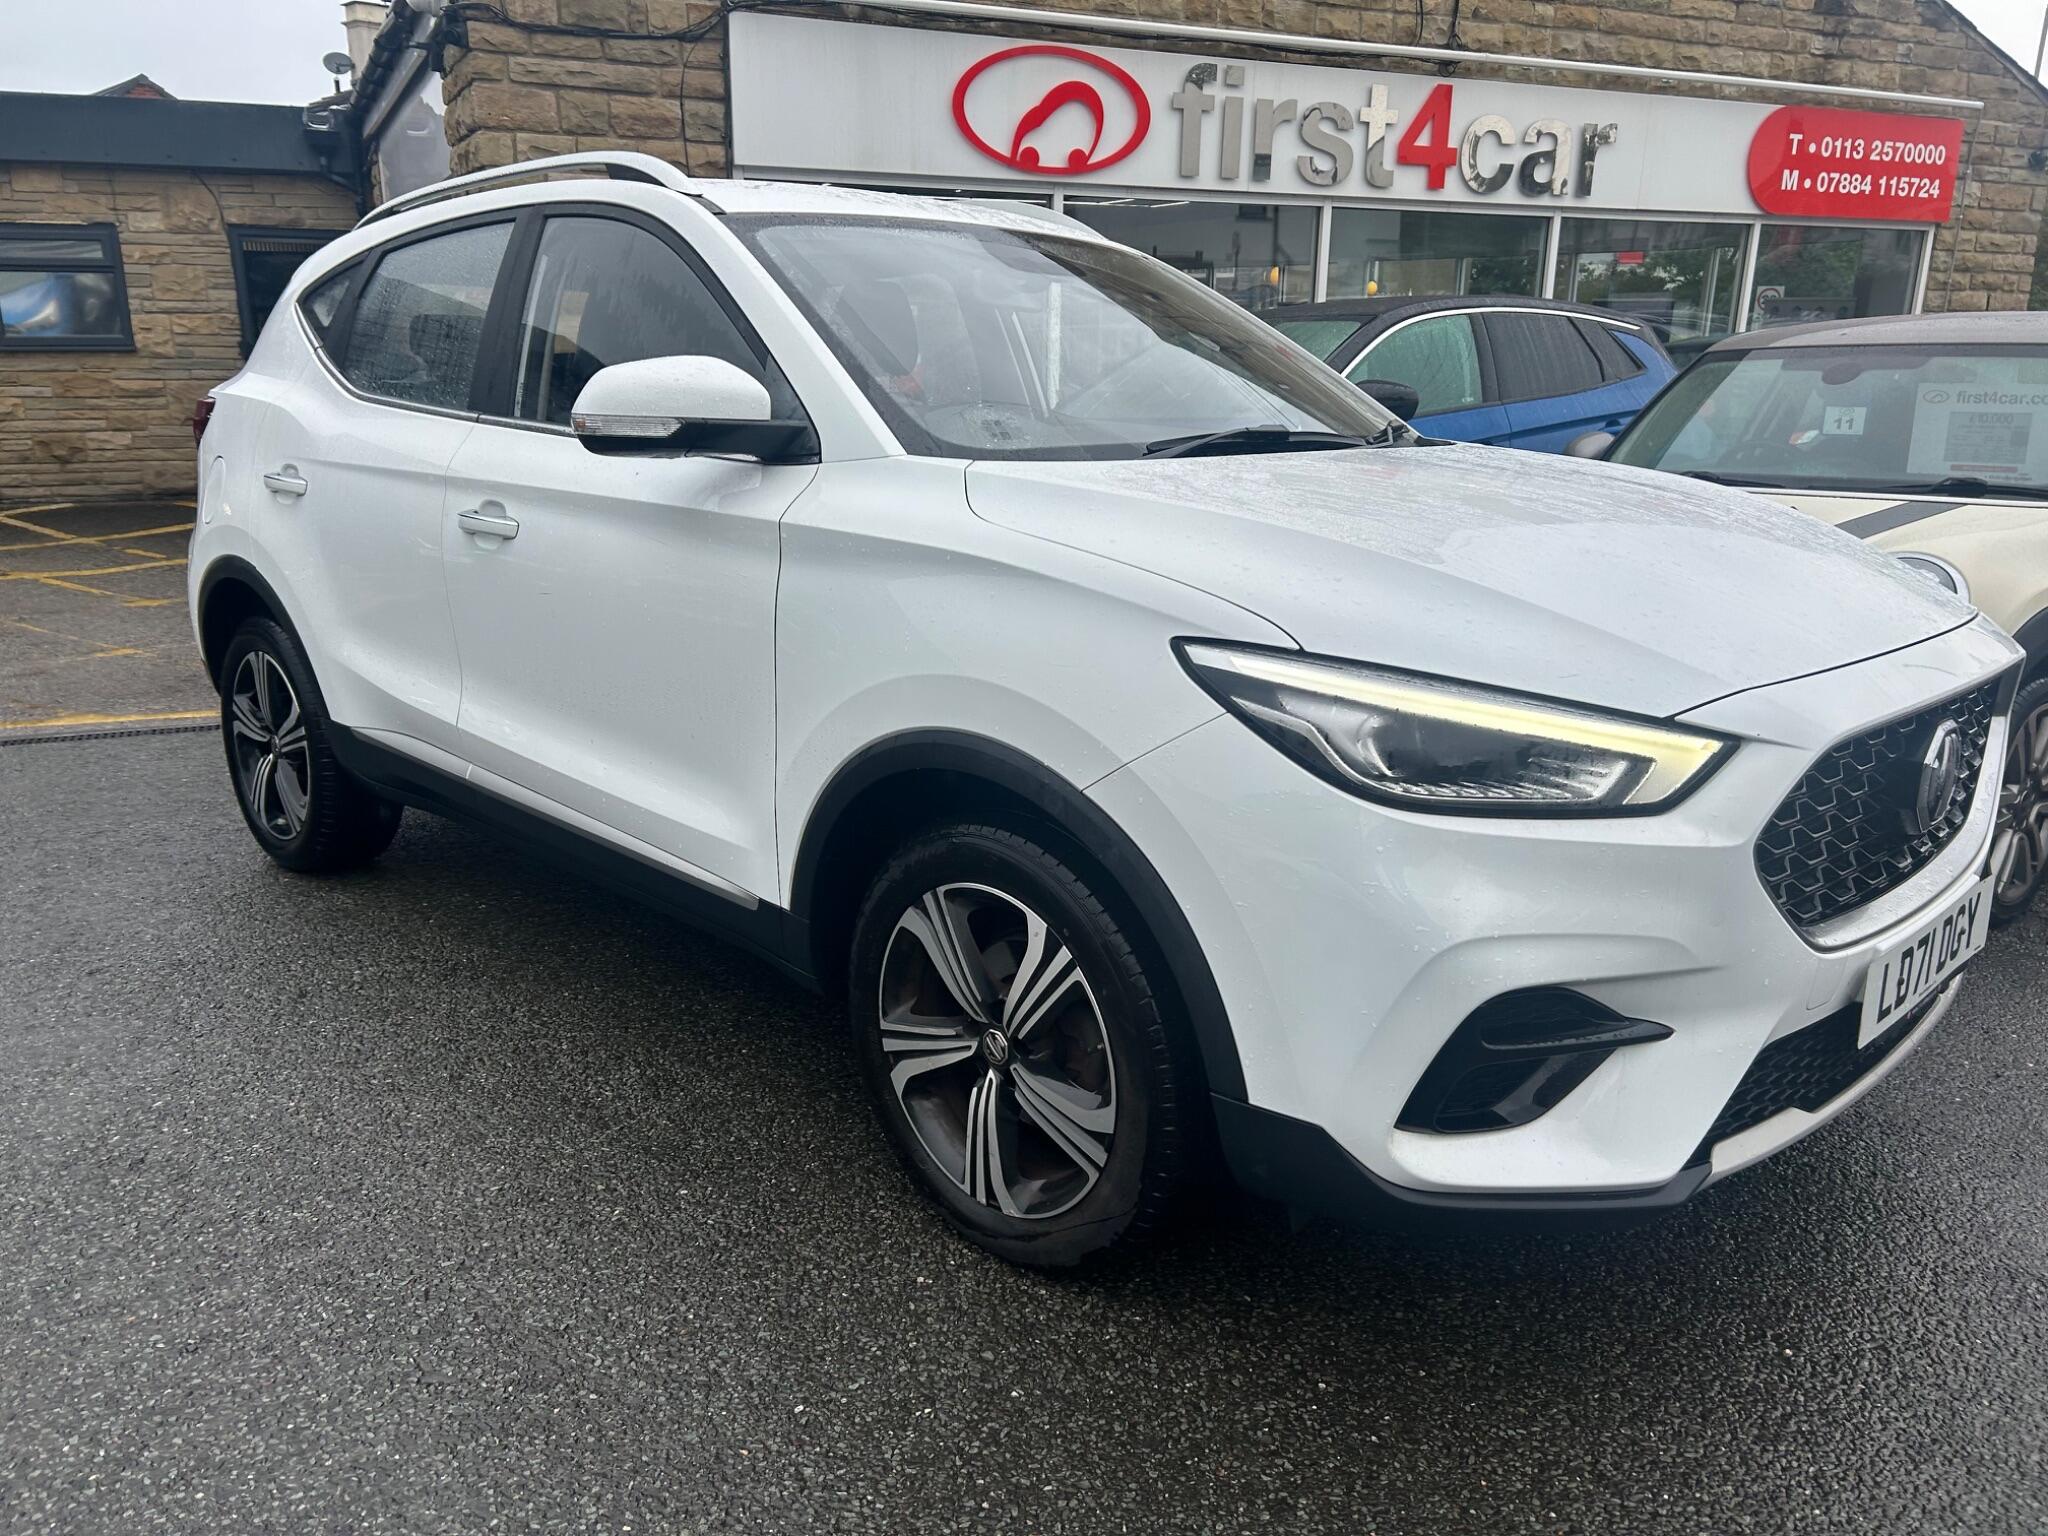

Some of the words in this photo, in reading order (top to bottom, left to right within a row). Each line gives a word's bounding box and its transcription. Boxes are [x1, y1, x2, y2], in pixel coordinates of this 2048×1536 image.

[1171, 62, 1618, 198] first4car
[1789, 133, 1803, 155] T
[1821, 136, 1865, 160] 0113
[1869, 140, 1946, 165] 2570000
[1781, 169, 1800, 191] M
[1816, 172, 1872, 195] 07884
[1879, 176, 1940, 199] 115724
[1834, 417, 1854, 431] 11
[1877, 927, 1937, 1024] LD71
[1936, 892, 1981, 975] DGY
